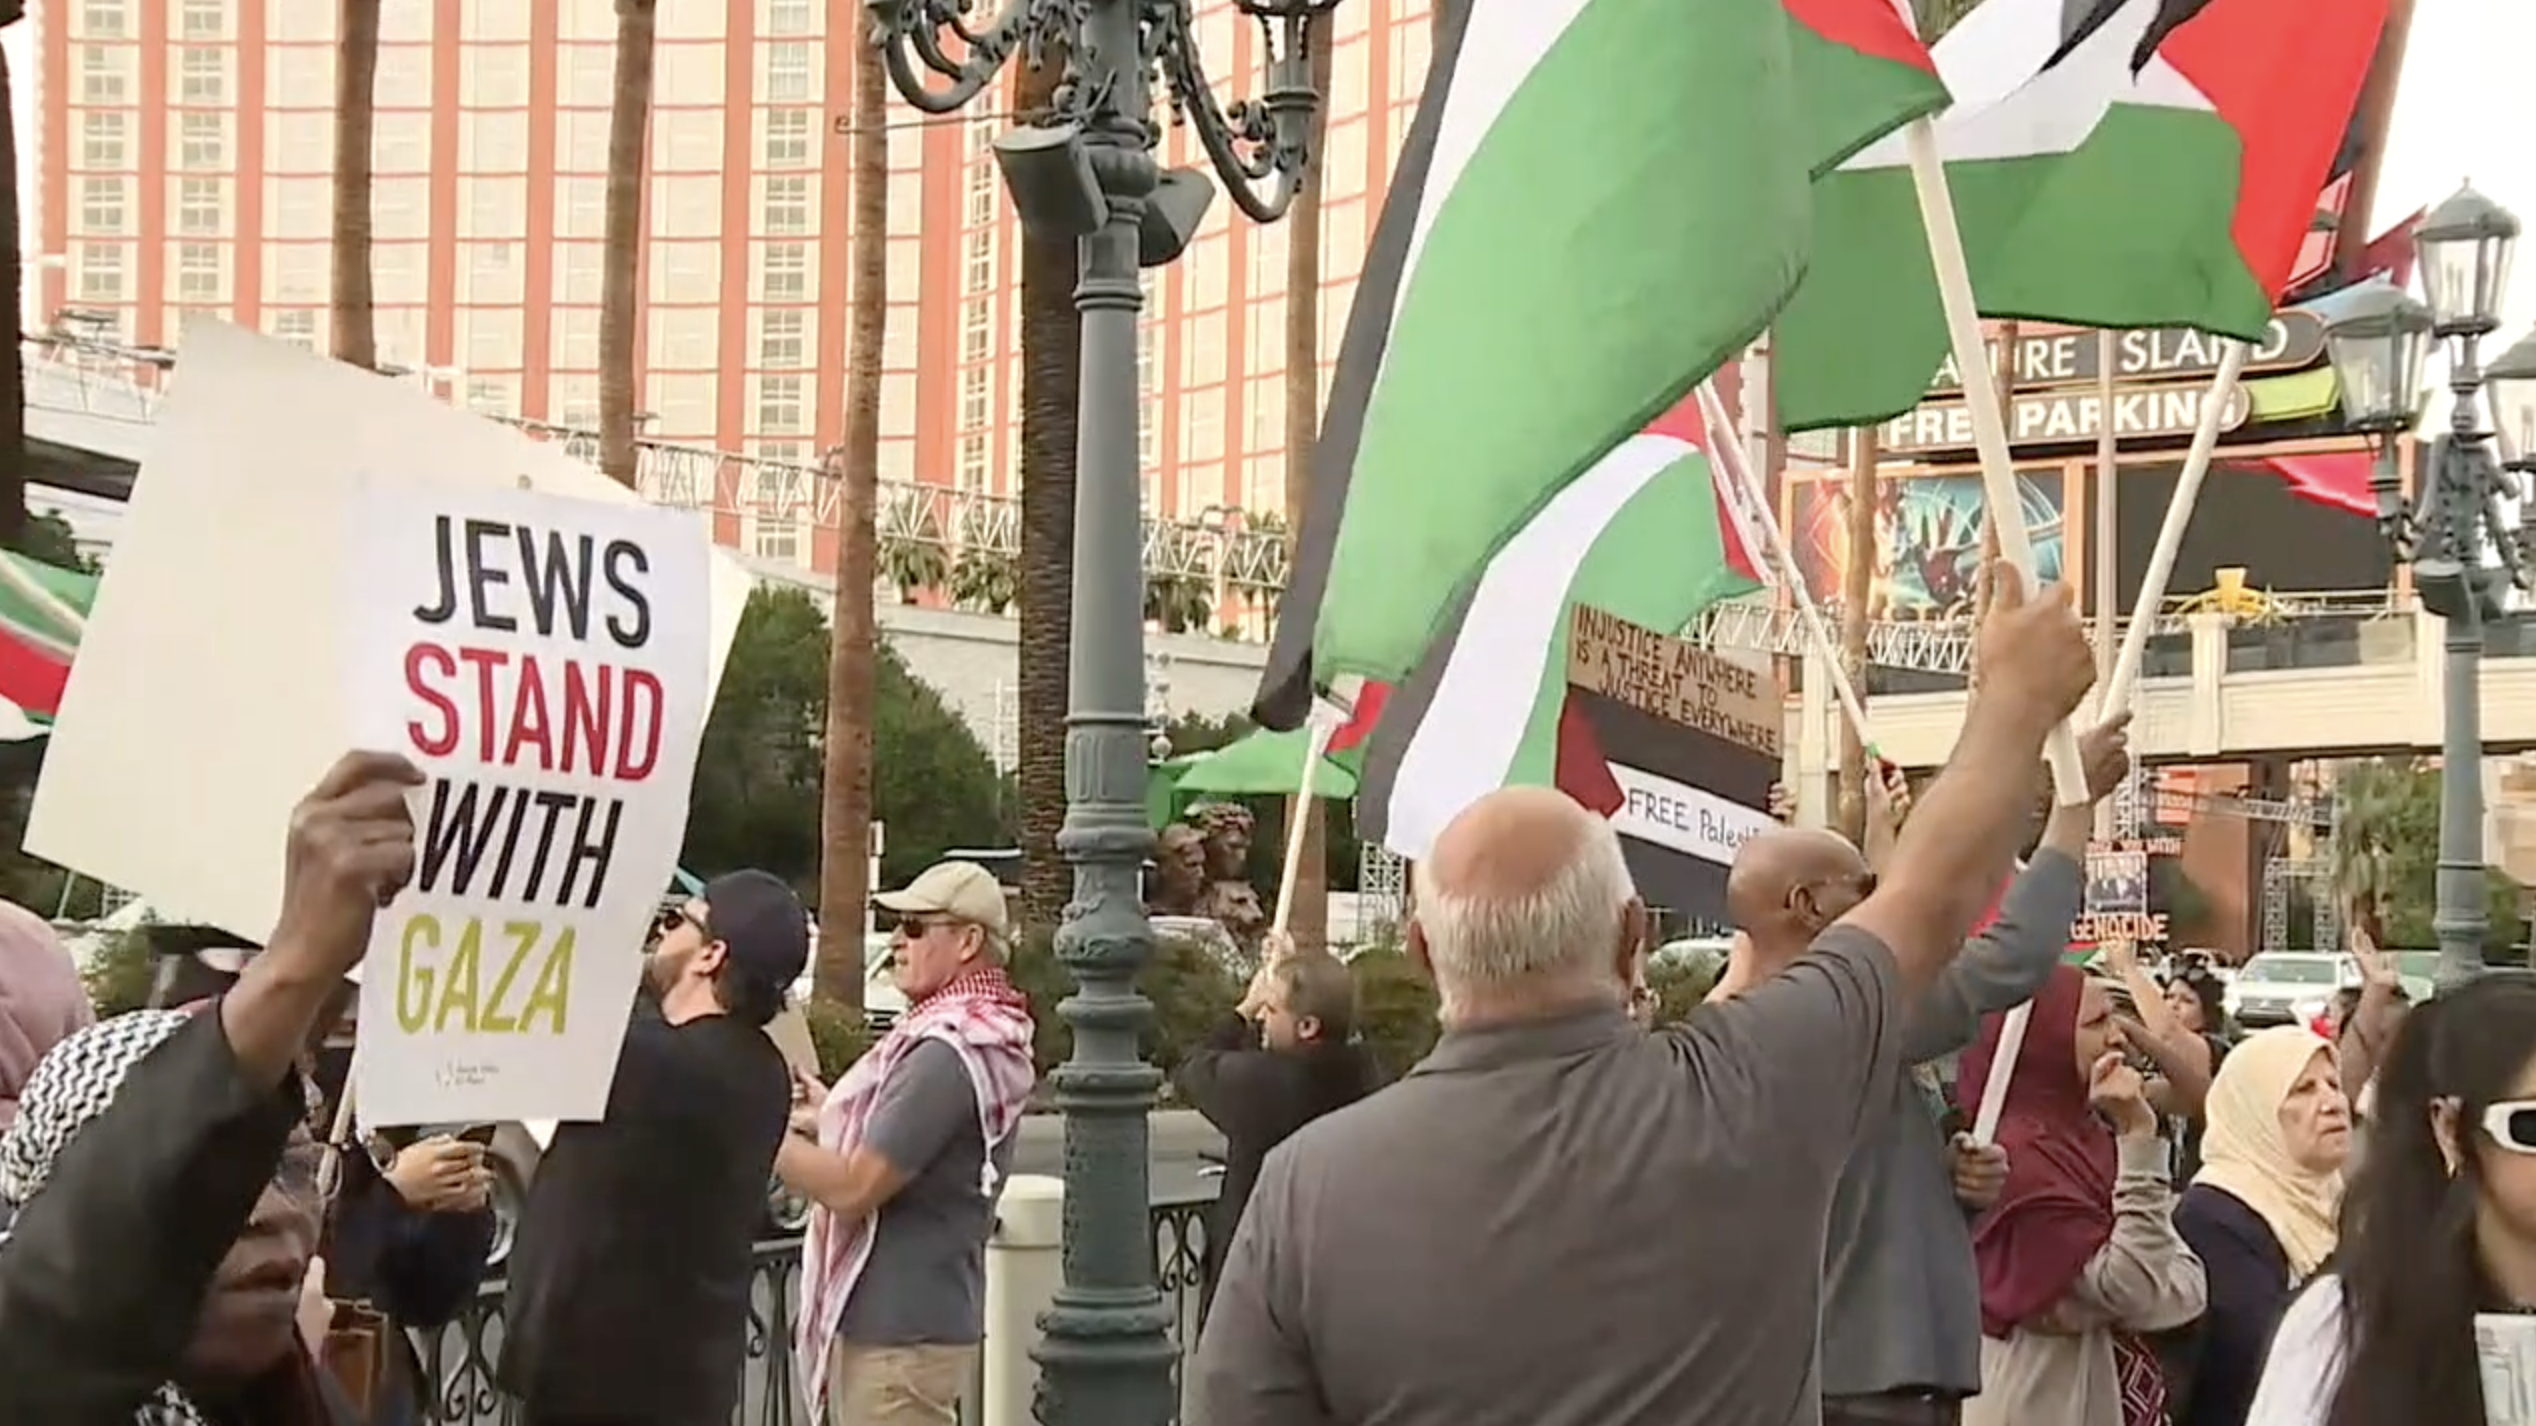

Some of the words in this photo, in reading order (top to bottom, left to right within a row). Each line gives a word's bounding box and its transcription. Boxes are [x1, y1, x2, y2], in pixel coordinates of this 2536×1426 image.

[2121, 318, 2288, 372] SLAD
[1889, 406, 1974, 447] FRE
[412, 515, 651, 648] JEWS
[1575, 638, 1590, 664] IS
[1601, 649, 1611, 670] A
[1617, 652, 1683, 695] THREAT
[1697, 682, 1717, 706] TO
[1577, 604, 1663, 660] INJUSTICE
[1676, 646, 1757, 699] ANYWHERE
[404, 641, 665, 783] STAND
[1597, 668, 1671, 717] JUSTICE
[1681, 700, 1777, 753] EVERYWHERE
[417, 776, 624, 909] WITH
[1626, 788, 1691, 831] FREE
[2069, 914, 2170, 941] GENOCIDE
[395, 914, 576, 1035] GAZA
